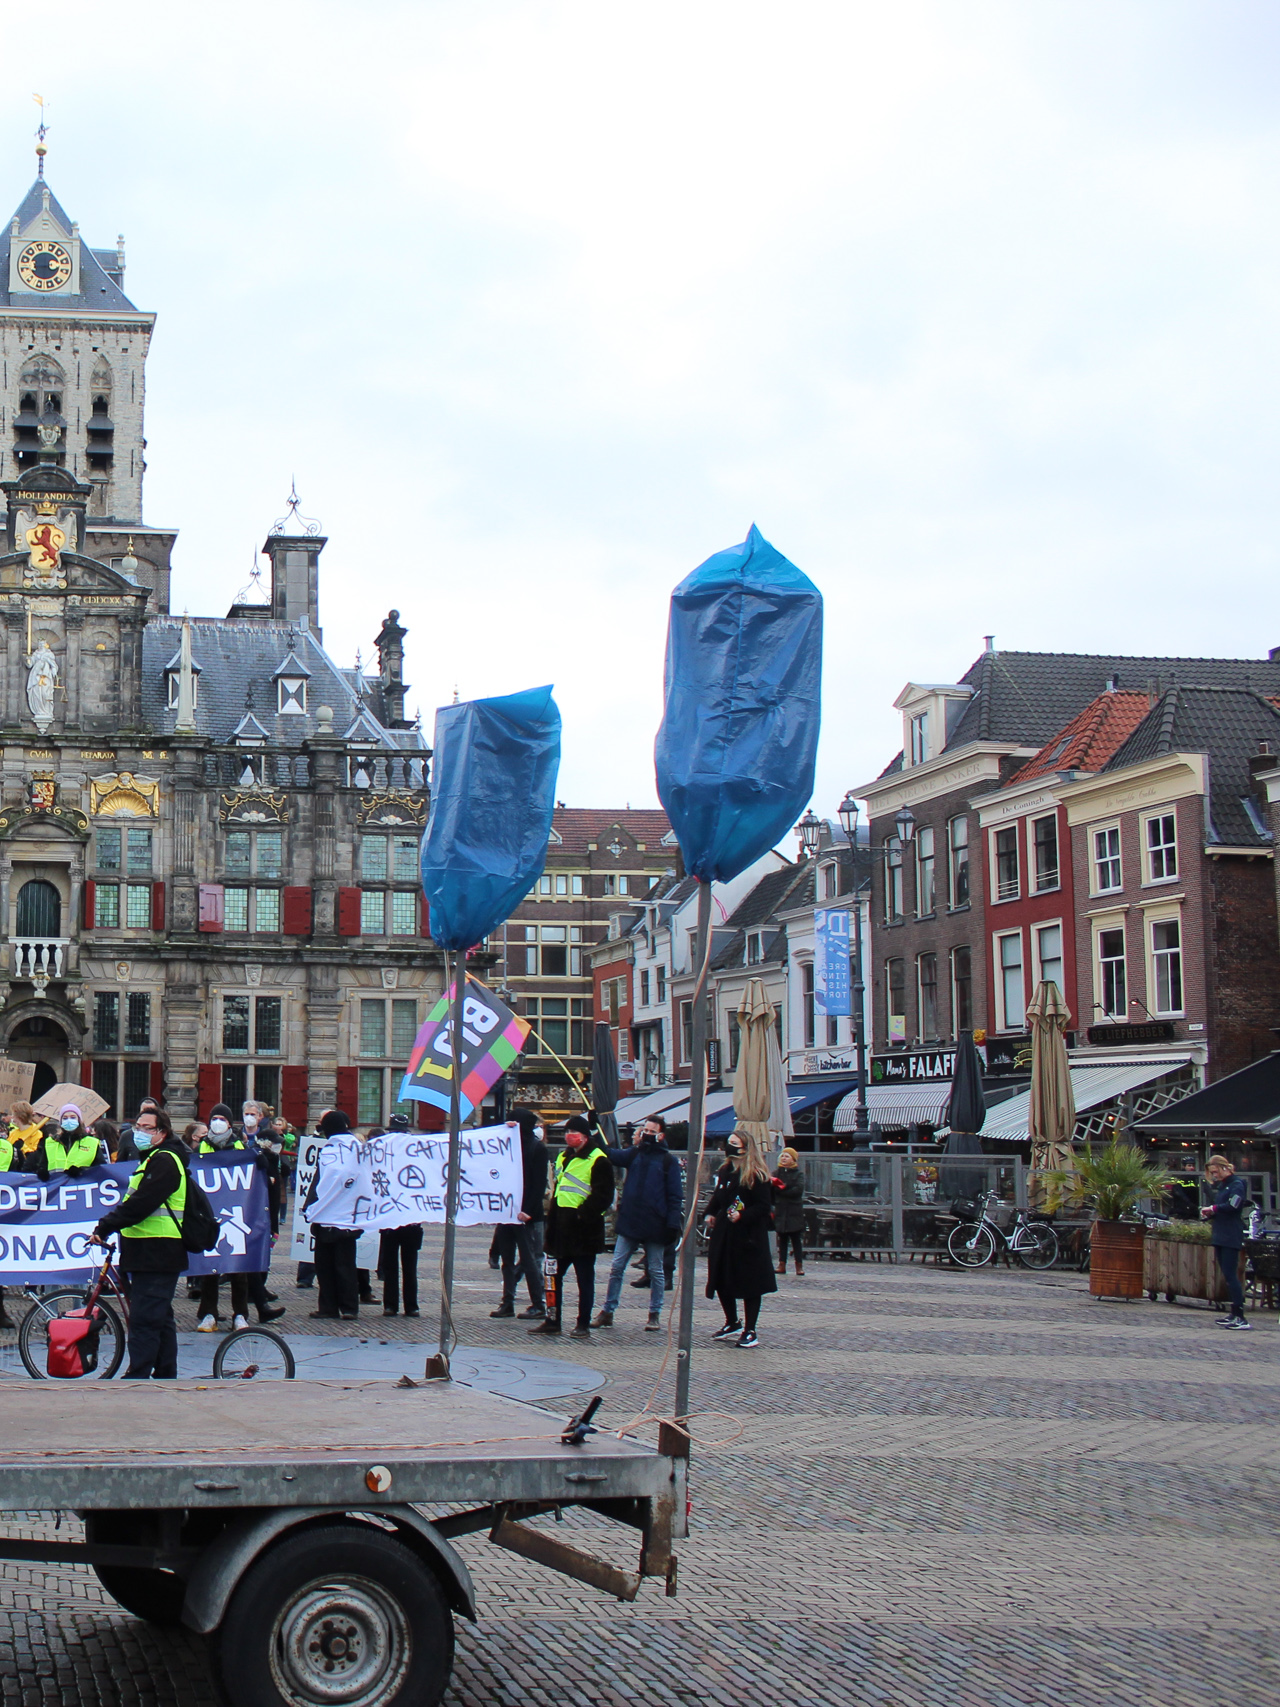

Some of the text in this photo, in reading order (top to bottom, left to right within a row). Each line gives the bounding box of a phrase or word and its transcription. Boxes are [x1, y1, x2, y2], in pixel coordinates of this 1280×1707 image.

[1092, 1025, 1166, 1041] DE LIEFHEBBER
[886, 1060, 907, 1078] Mama's
[321, 1138, 395, 1172] SMASH
[352, 1192, 410, 1224] FUCK
[410, 1194, 444, 1212] THE
